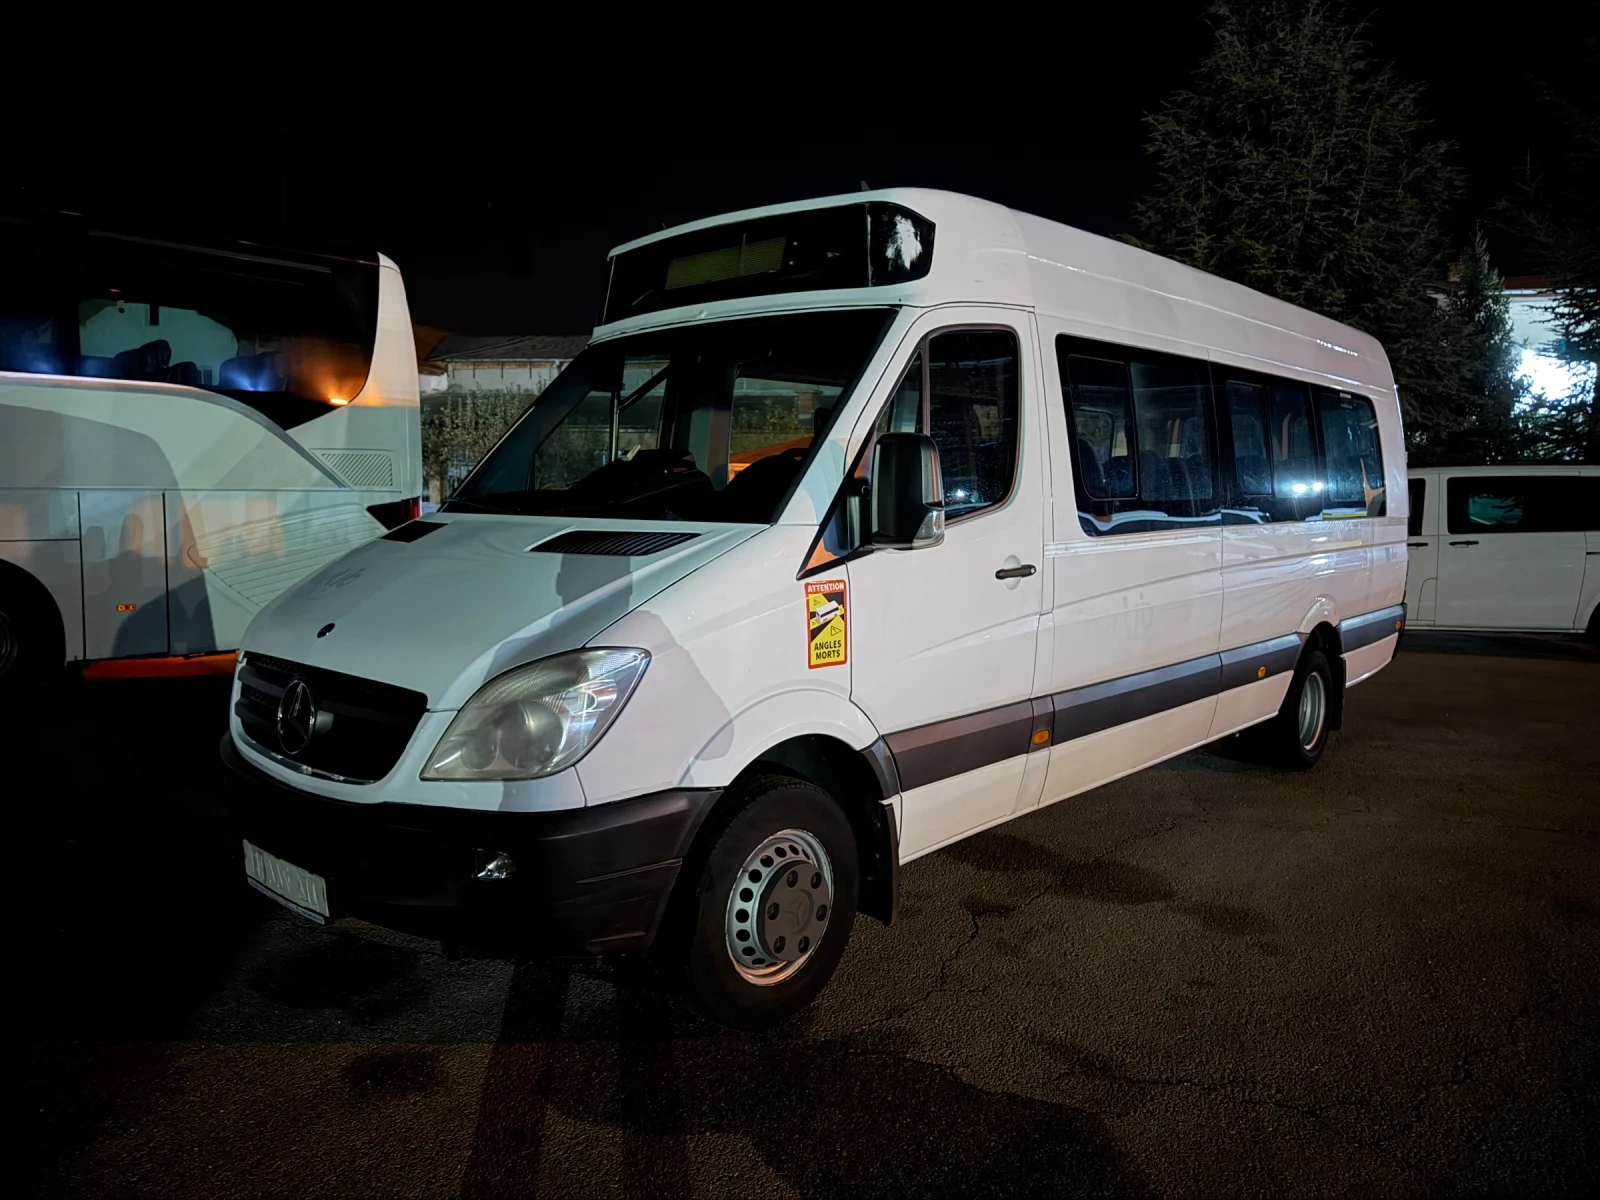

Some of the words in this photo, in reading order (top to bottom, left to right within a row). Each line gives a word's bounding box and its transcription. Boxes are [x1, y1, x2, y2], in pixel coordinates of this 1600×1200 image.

[807, 582, 844, 592] ATTENTION
[814, 640, 842, 651] ANGLES
[815, 650, 840, 660] MORTS
